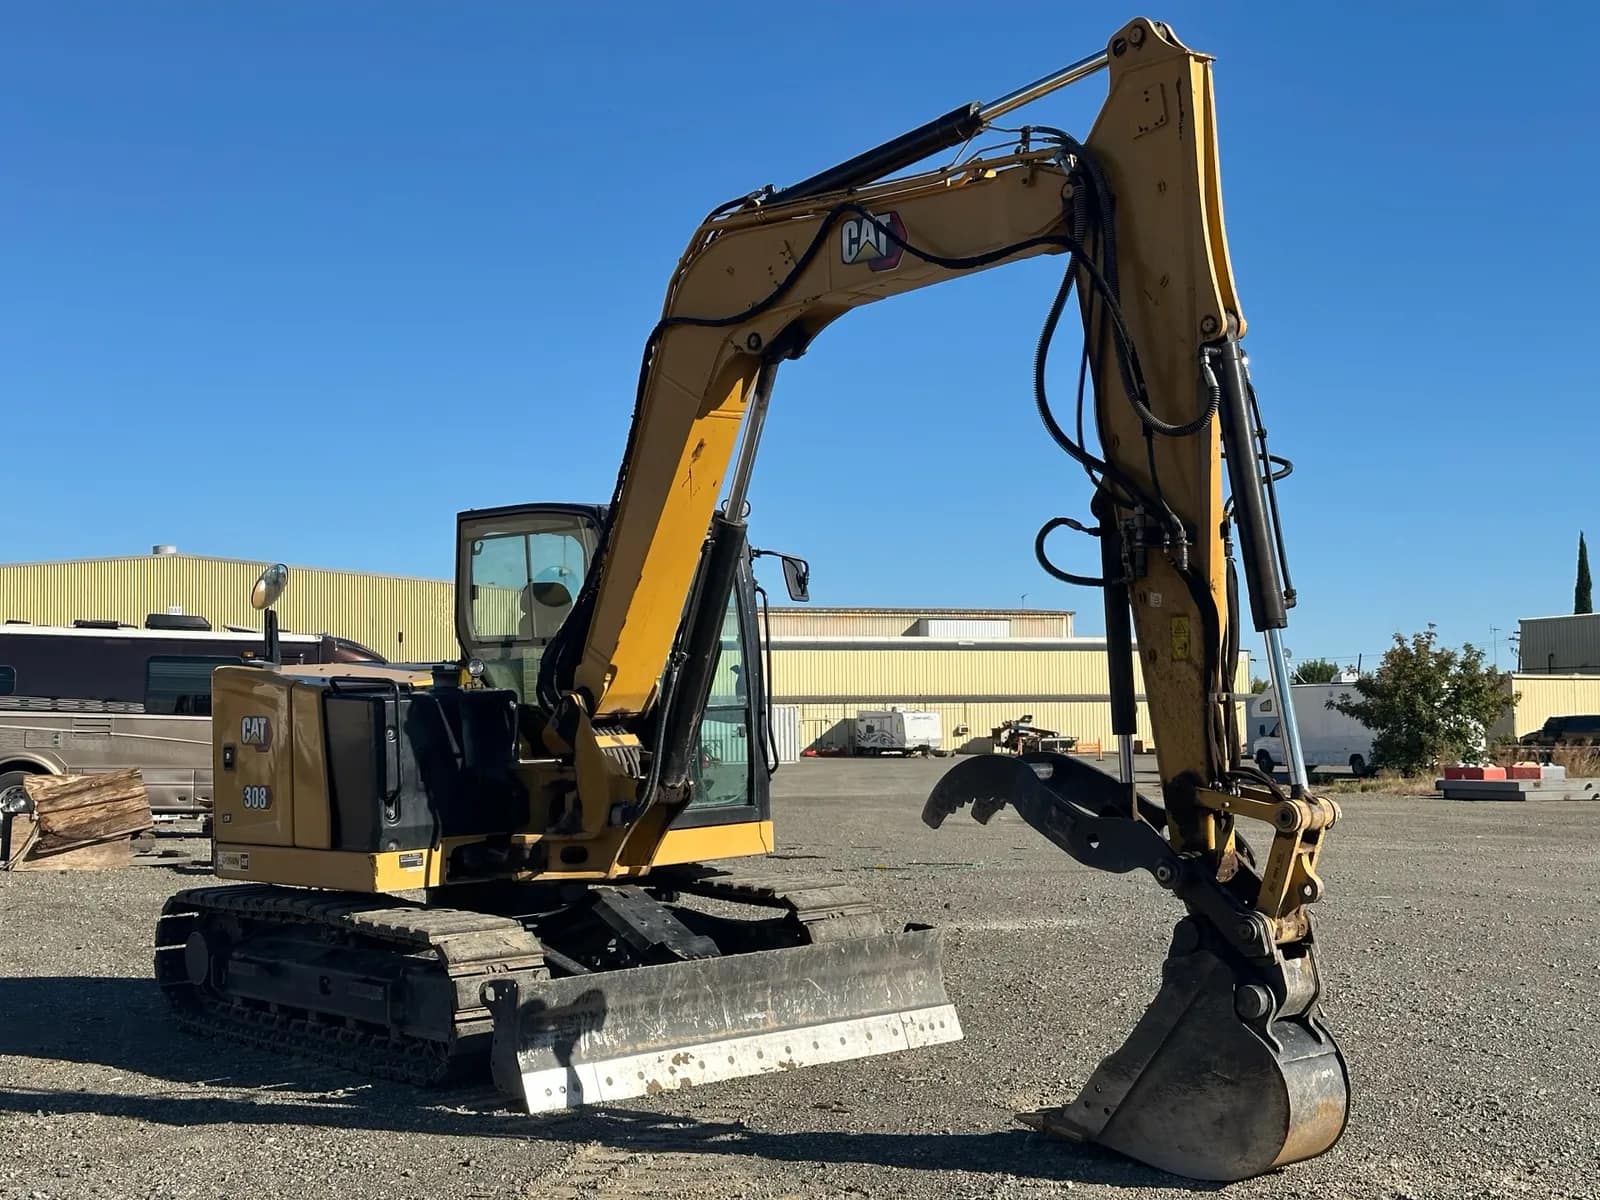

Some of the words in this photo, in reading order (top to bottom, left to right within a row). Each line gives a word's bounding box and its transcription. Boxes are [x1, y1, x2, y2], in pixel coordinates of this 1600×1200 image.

[842, 213, 891, 262] CAT
[242, 718, 266, 744] CAT
[245, 787, 266, 808] 308
